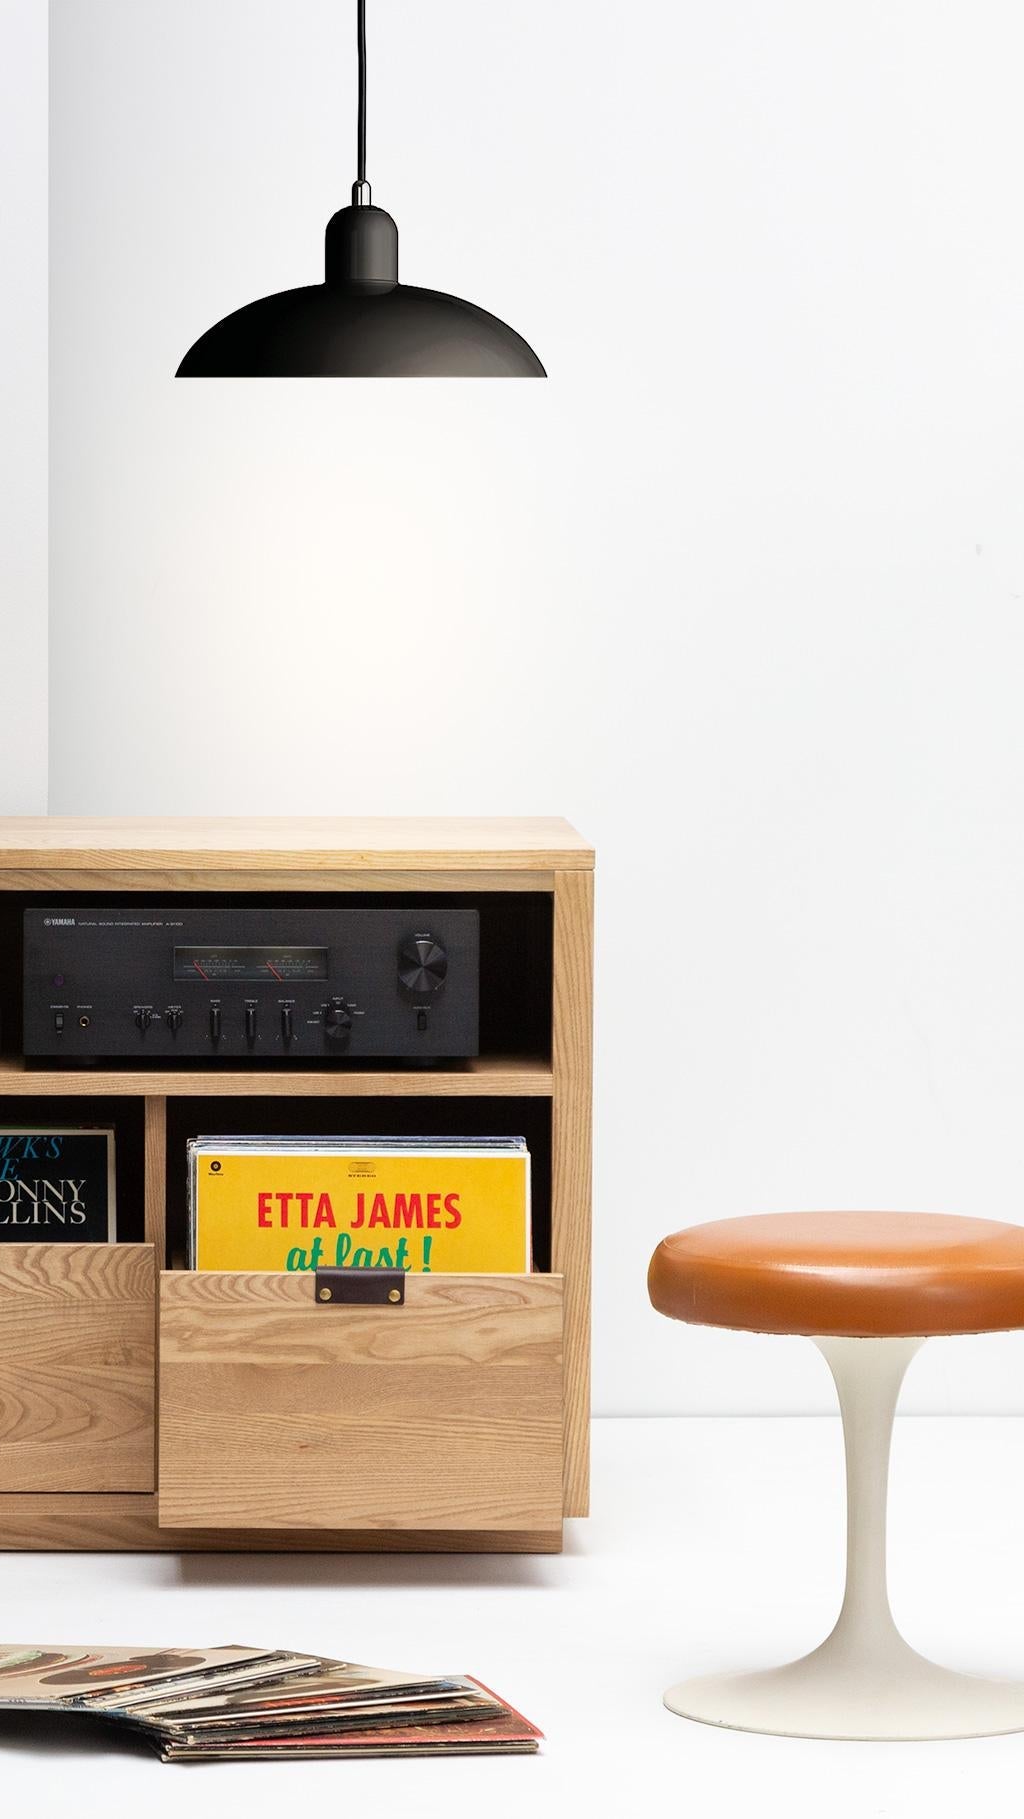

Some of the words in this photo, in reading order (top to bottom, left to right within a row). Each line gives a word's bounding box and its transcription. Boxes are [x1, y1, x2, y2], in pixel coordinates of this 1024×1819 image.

[51, 918, 76, 927] YAMAHA
[257, 1192, 337, 1228] ETTA
[350, 1192, 462, 1229] JAMES
[286, 1236, 324, 1272] at
